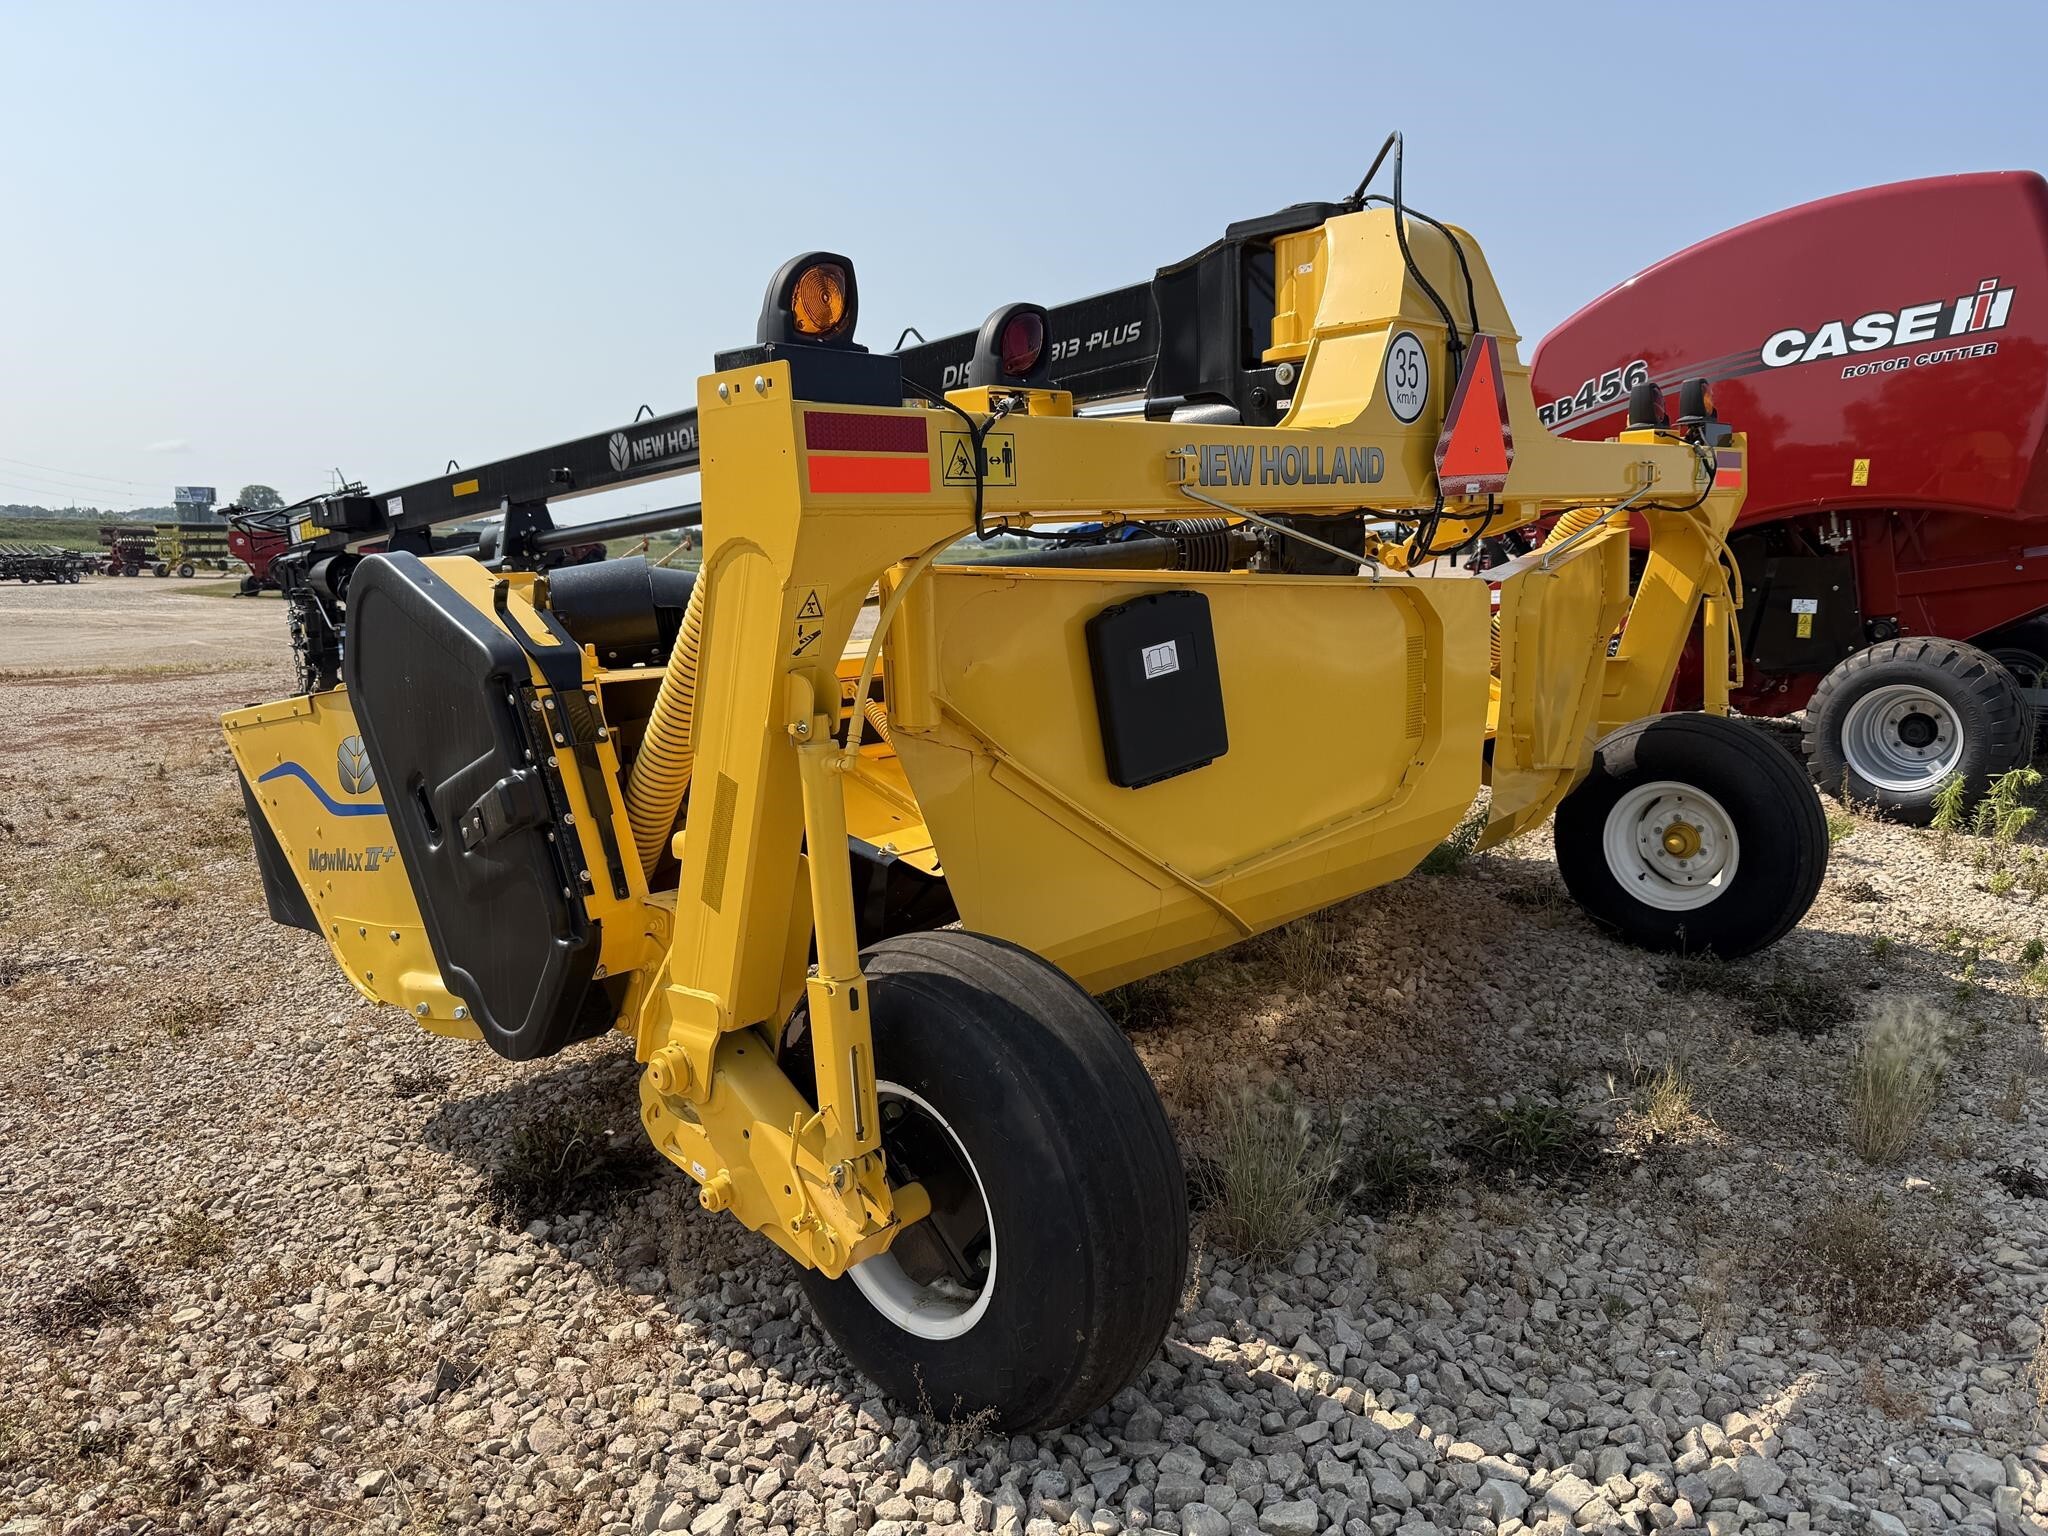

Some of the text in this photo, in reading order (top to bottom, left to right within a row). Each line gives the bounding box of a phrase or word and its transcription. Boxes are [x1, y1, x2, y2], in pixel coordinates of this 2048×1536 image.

[1761, 301, 1943, 367] CASE
[942, 360, 973, 389] DIS
[1395, 347, 1418, 389] 35
[1841, 342, 1999, 379] ROTOR CUTTER
[1396, 391, 1417, 405] km/h
[1537, 360, 1648, 427] RB456
[632, 426, 698, 462] NEW HOL
[1186, 444, 1385, 486] NEW HOLLAND
